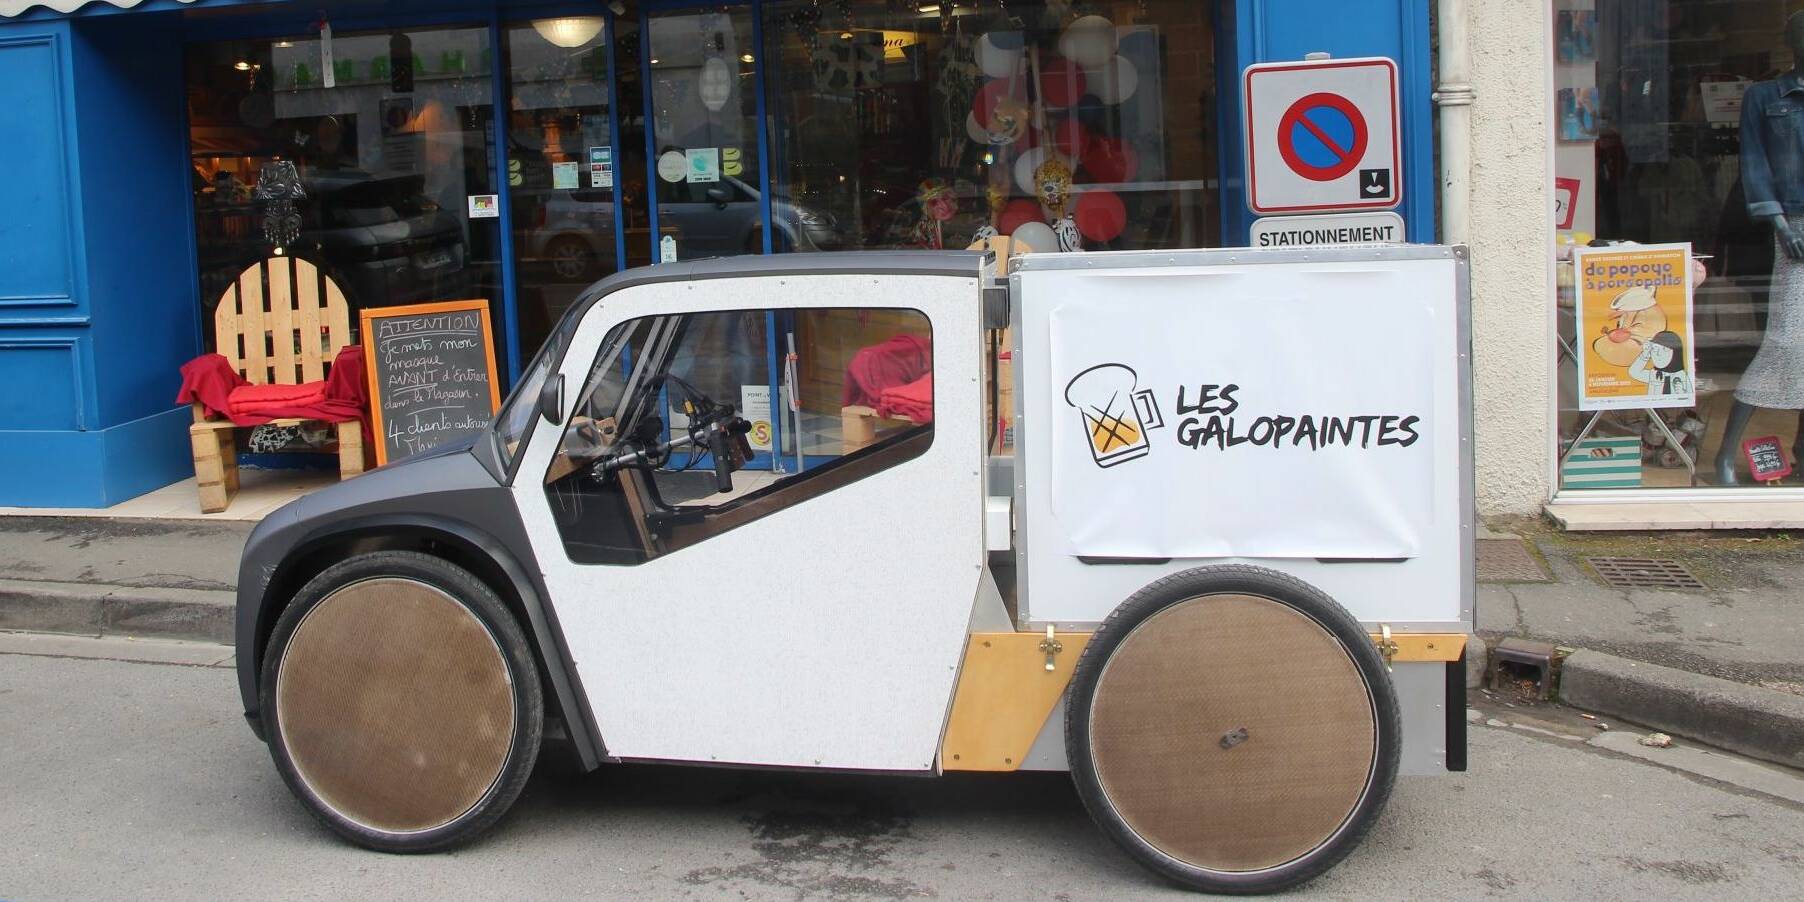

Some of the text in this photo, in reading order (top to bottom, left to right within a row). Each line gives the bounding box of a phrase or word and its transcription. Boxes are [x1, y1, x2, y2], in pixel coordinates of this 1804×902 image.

[1260, 226, 1394, 247] STATIONNEMENT
[379, 312, 480, 338] ATTENTION
[380, 337, 477, 363] Je mets mon
[390, 355, 444, 373] masque
[389, 369, 438, 388] AVANT
[384, 395, 410, 410] dans
[414, 388, 424, 402] le
[1177, 384, 1239, 415] LES
[389, 419, 404, 448] 4
[408, 412, 452, 435] clients
[1177, 414, 1420, 451] GALOPAINTES
